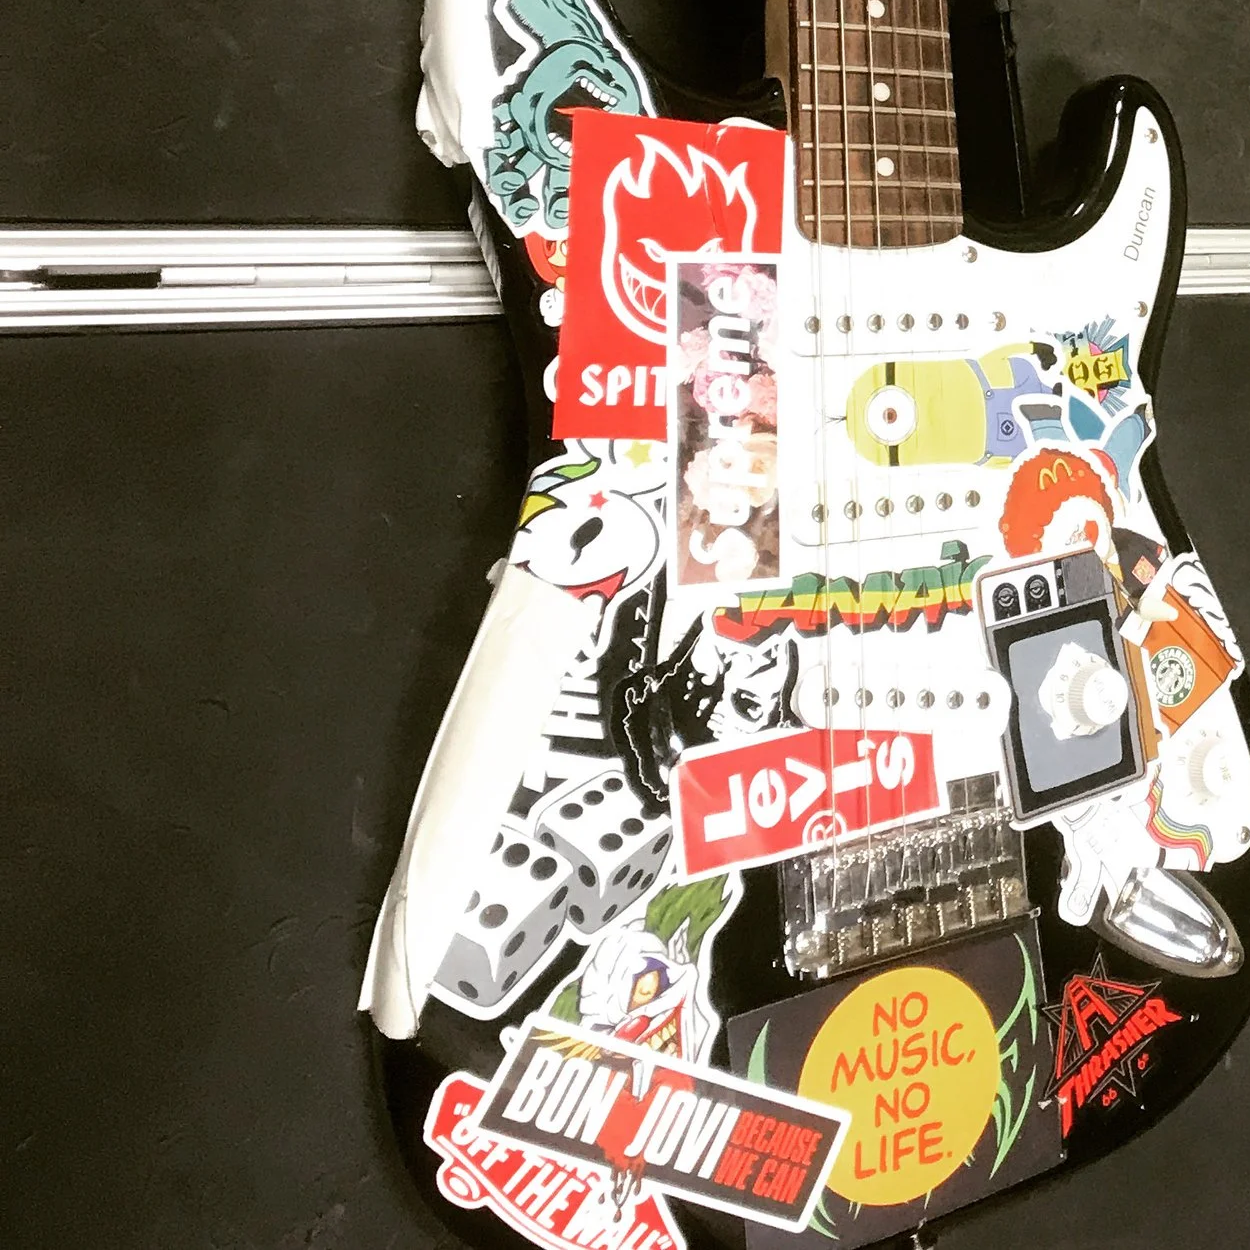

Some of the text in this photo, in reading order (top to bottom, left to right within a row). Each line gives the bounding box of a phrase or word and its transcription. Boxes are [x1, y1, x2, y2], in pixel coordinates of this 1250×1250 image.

[1123, 186, 1156, 261] Duncan
[578, 364, 668, 406] SPIT
[711, 539, 993, 647] JAMAIC
[873, 991, 928, 1037] NO
[831, 1022, 976, 1093] MUSIC,
[1058, 997, 1183, 1139] THRASHER
[502, 1046, 741, 1181] BON JOVI
[875, 1081, 930, 1128] NO
[730, 1111, 823, 1166] BECAUSE
[854, 1121, 953, 1180] LIFE.
[501, 1150, 586, 1230] THE
[714, 1145, 808, 1205] WE CAN
